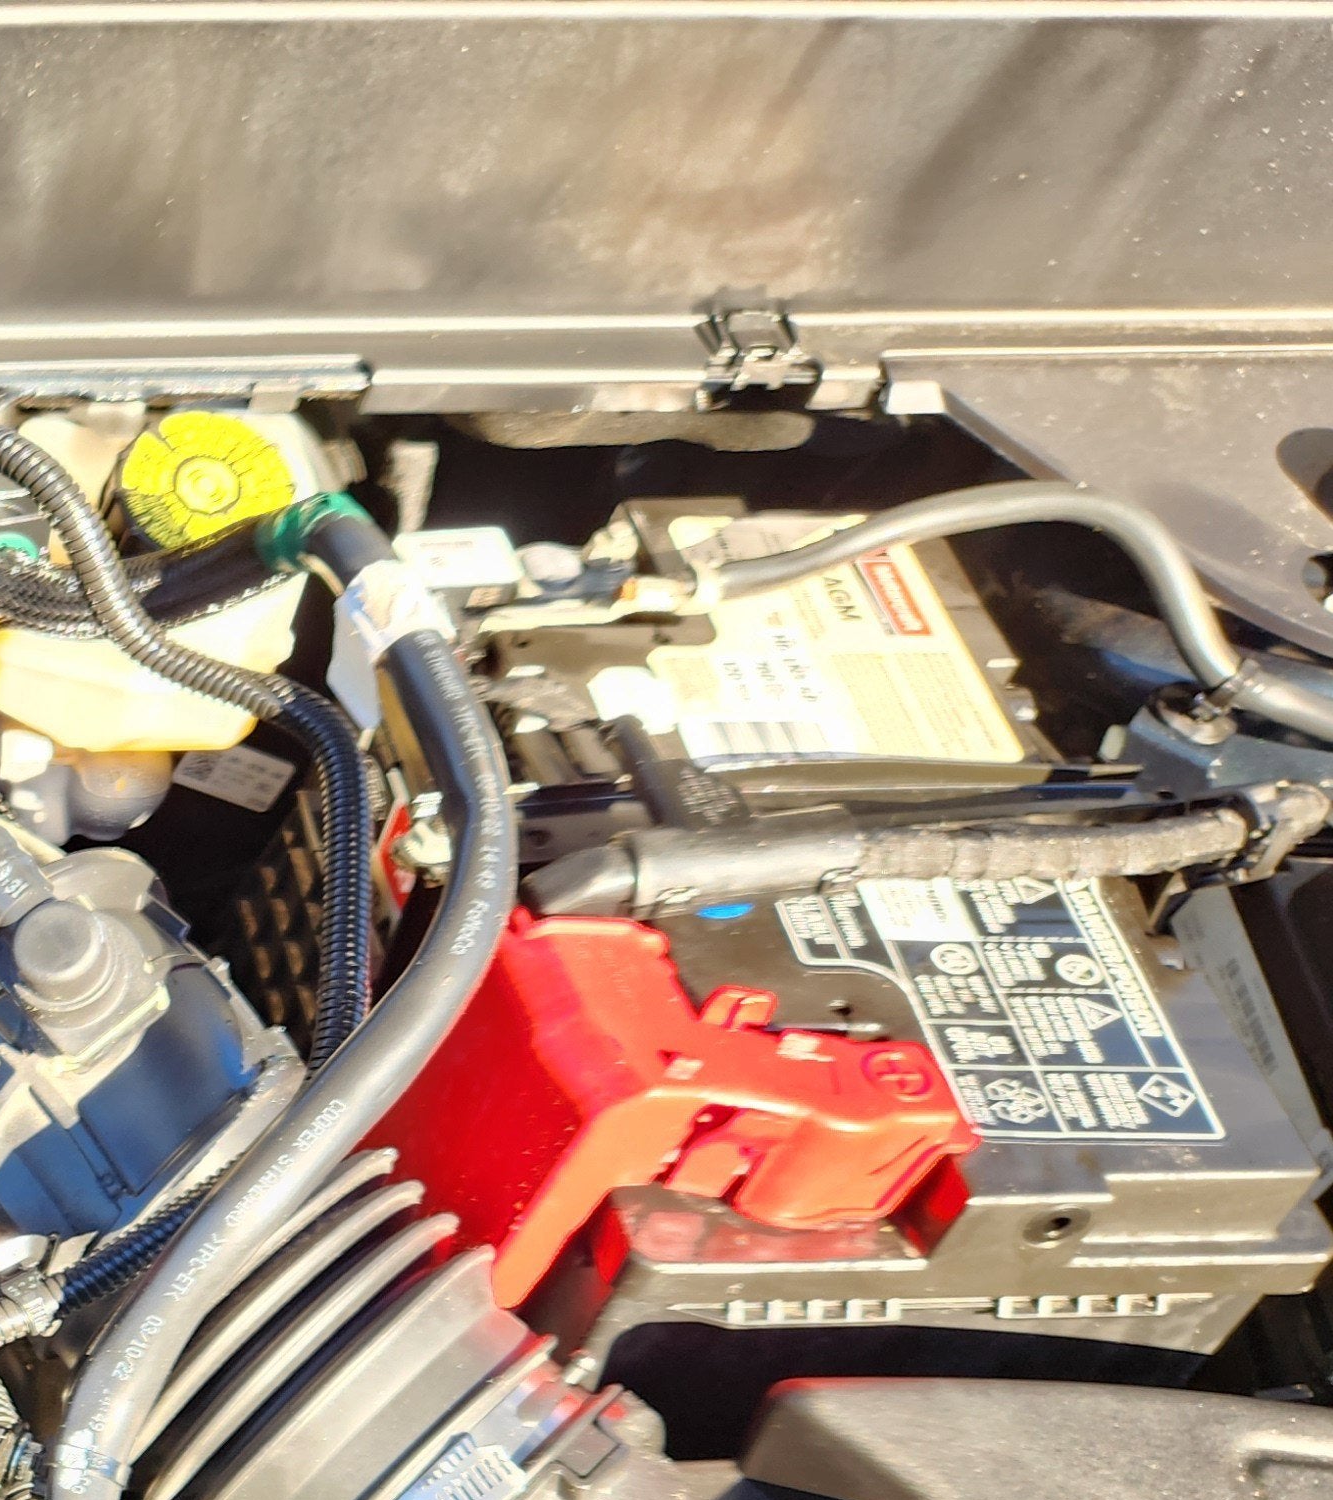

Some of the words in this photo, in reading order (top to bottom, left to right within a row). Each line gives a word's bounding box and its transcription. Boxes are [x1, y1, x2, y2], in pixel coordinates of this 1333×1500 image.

[822, 575, 863, 621] AGM
[1069, 890, 1163, 1037] DANGER/POISON
[291, 1099, 347, 1151] COOPER
